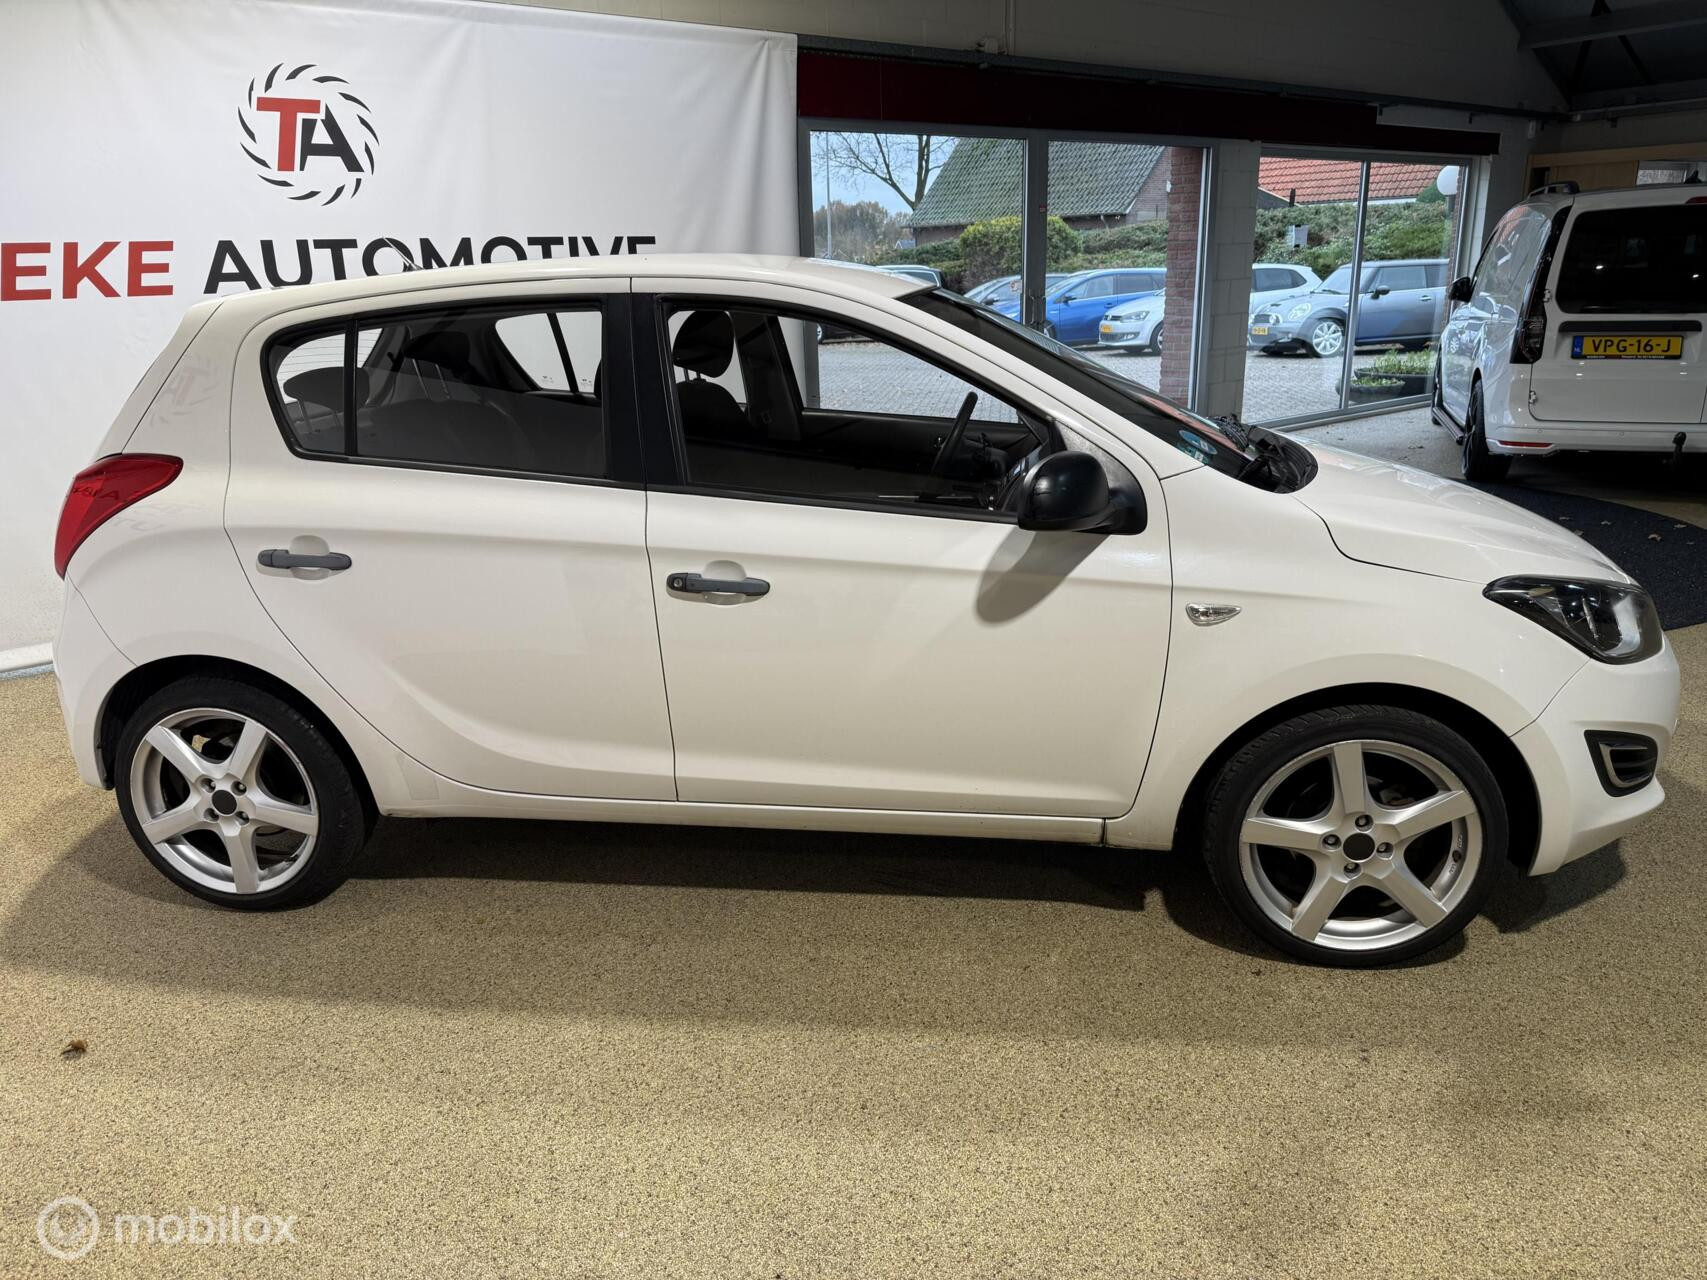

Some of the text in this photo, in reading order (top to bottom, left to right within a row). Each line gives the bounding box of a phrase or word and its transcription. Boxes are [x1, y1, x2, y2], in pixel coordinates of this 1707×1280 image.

[256, 97, 364, 172] TA
[1, 241, 174, 301] EKE
[1592, 338, 1671, 353] VPG-16-J
